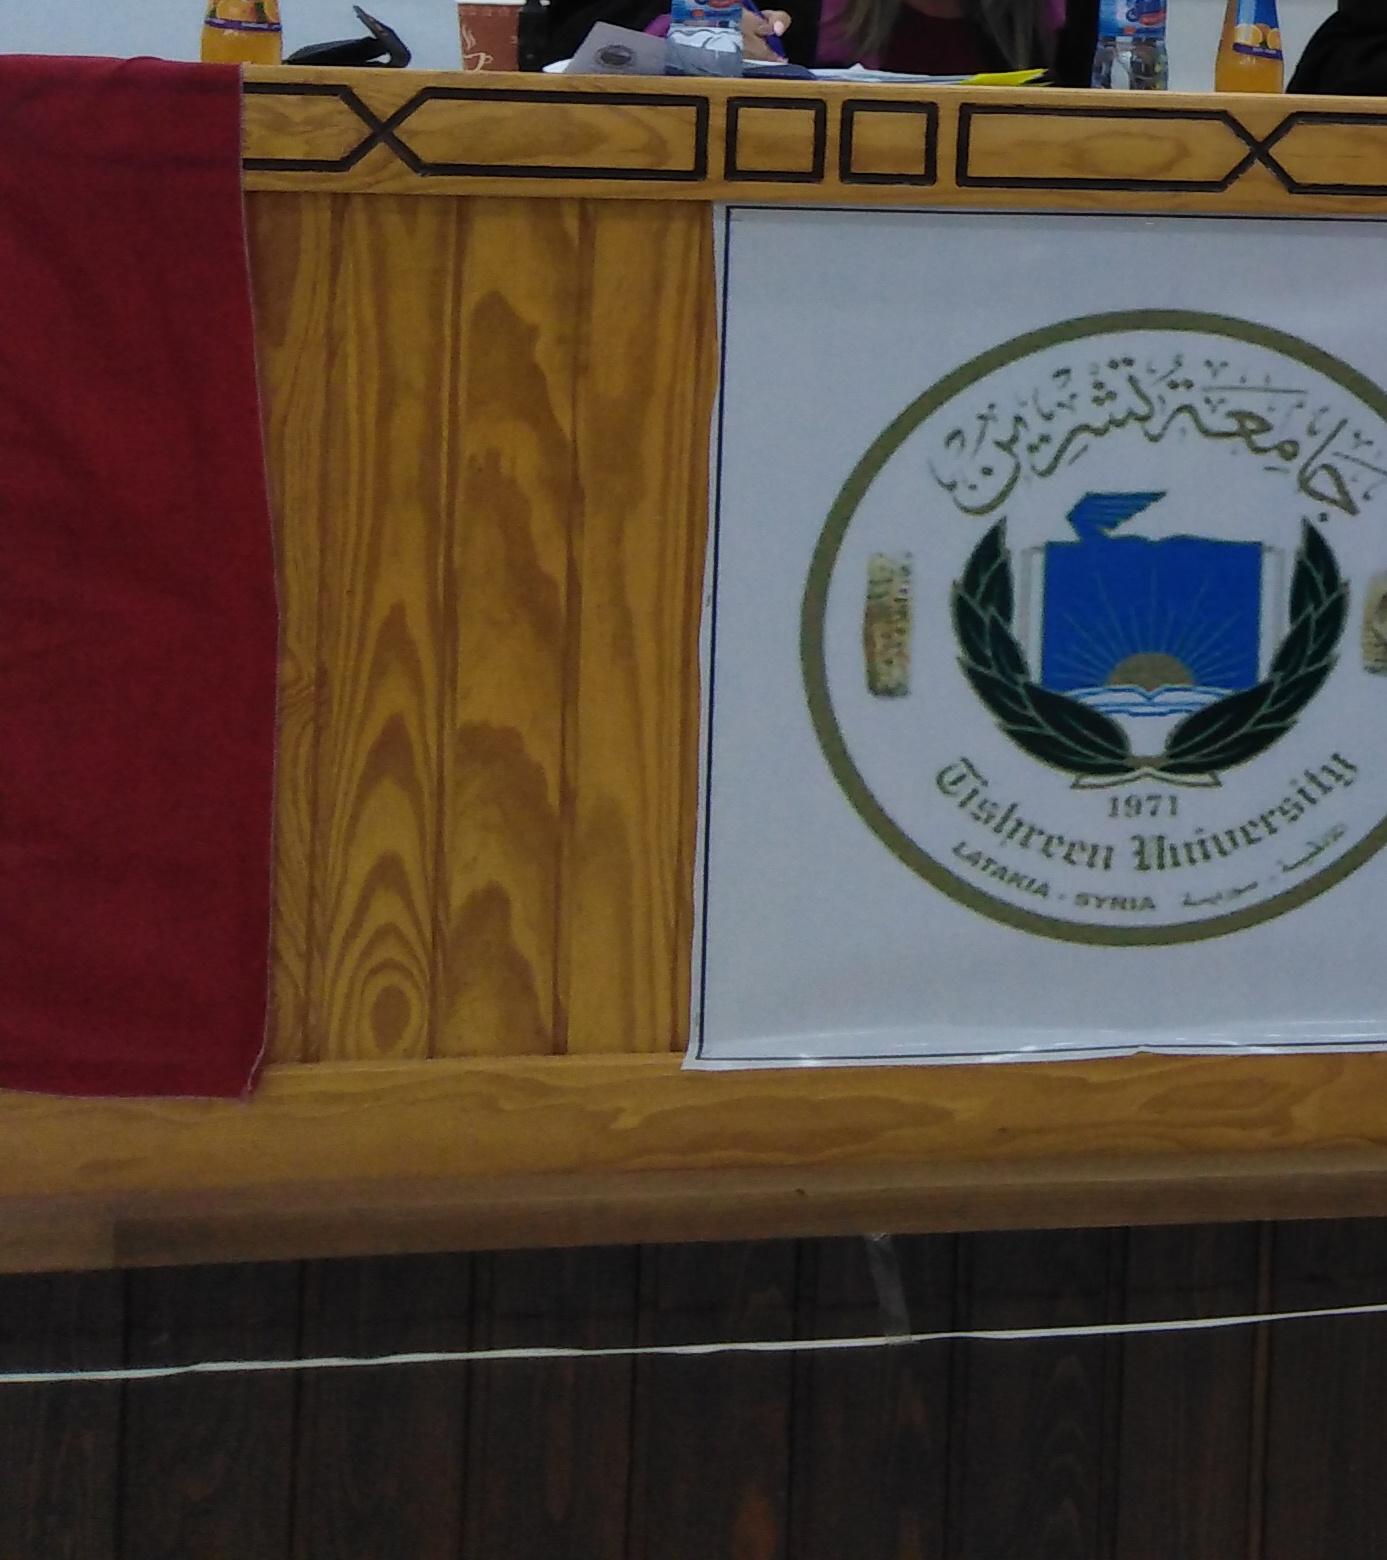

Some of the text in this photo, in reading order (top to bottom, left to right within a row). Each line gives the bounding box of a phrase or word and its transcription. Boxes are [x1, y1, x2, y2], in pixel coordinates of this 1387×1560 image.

[935, 753, 1359, 872] Tishreen University
[1107, 794, 1179, 818] 1971
[951, 841, 1157, 912] LATAKIA SYRIA
